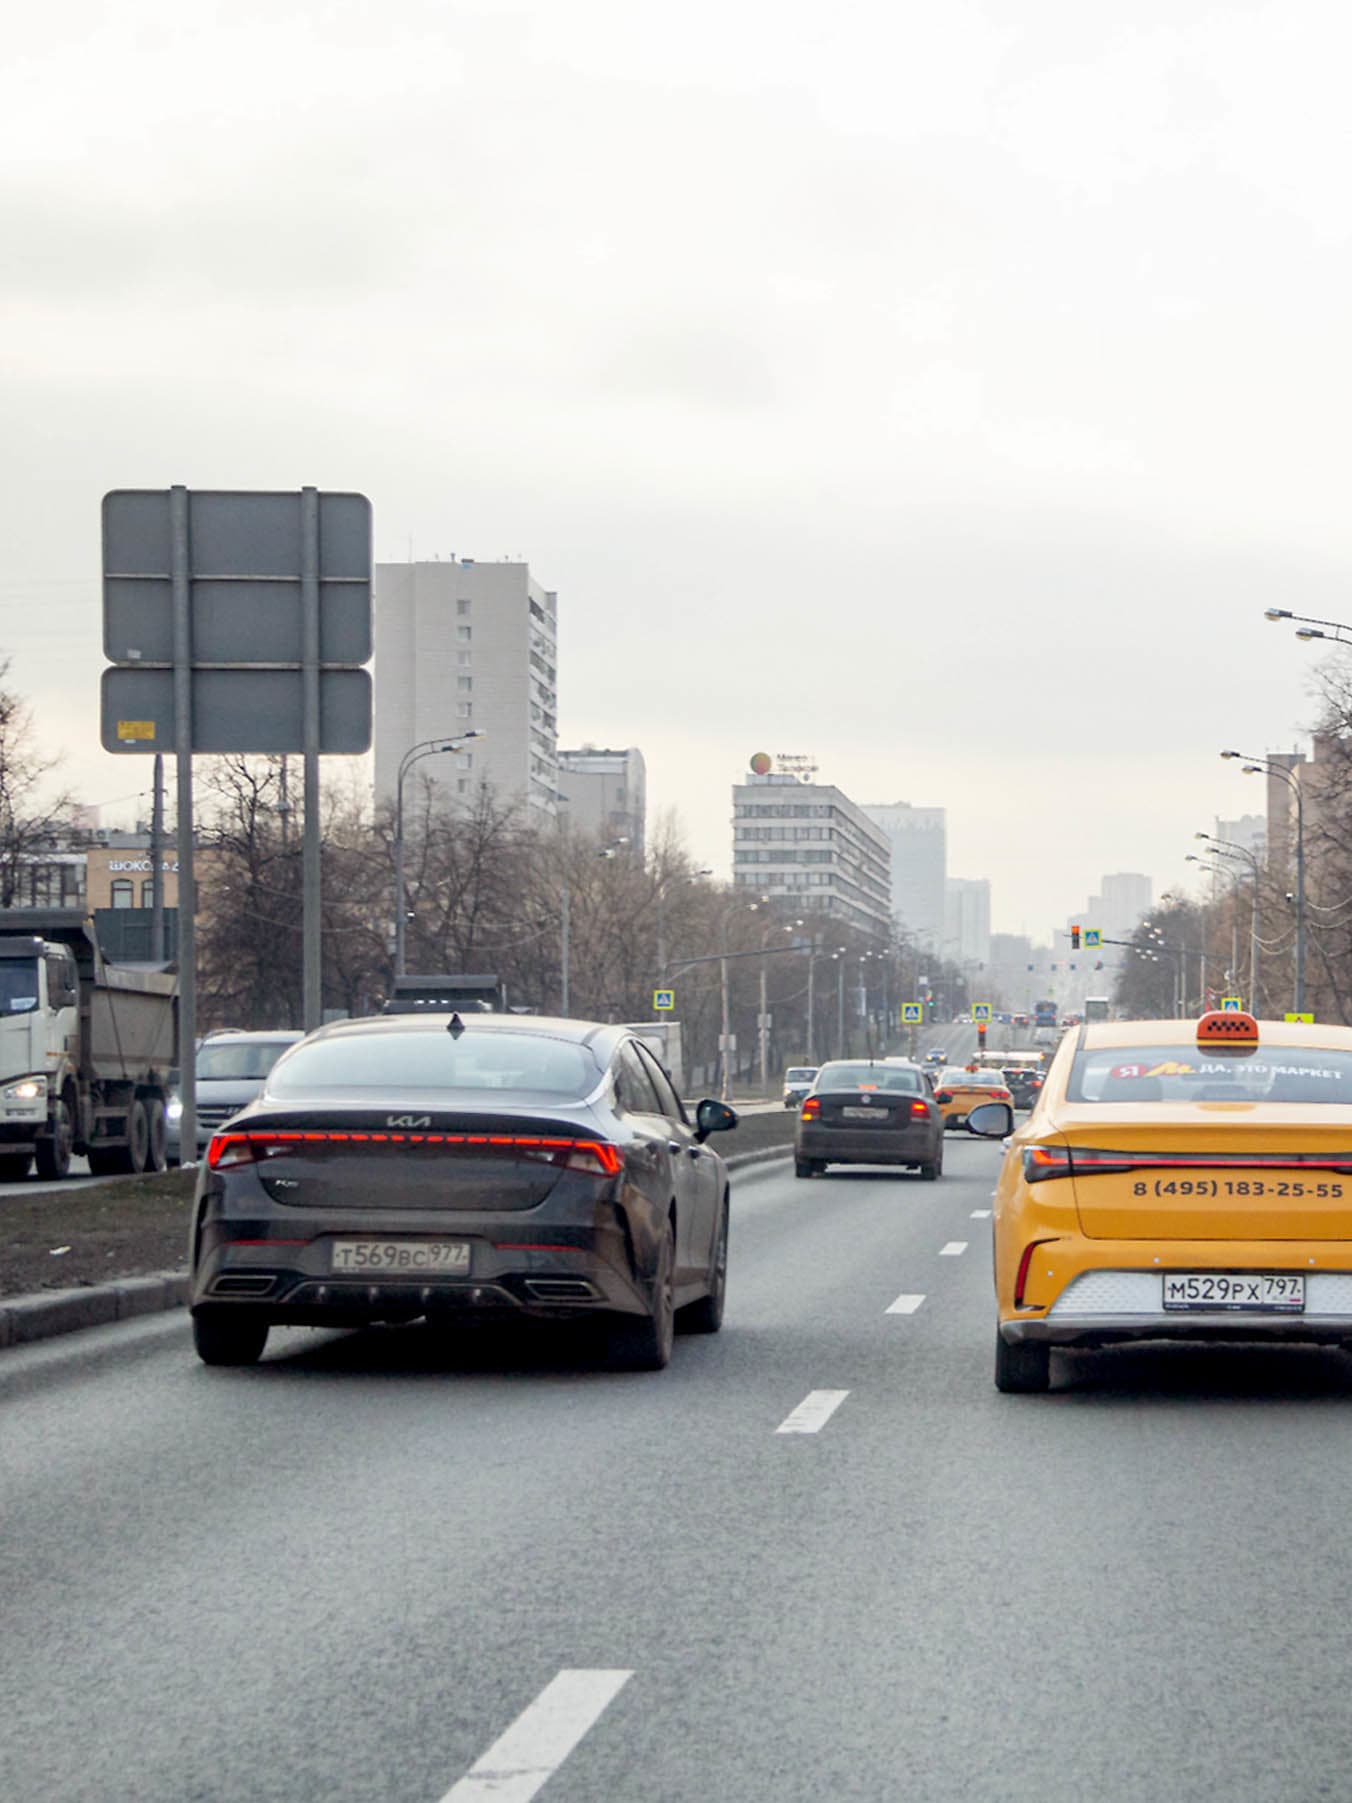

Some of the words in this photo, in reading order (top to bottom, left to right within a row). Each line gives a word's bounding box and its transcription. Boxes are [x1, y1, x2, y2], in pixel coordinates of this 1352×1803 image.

[1237, 1064, 1267, 1073] ЭТО
[1270, 1066, 1343, 1079] МАРКЕТ
[387, 1115, 432, 1127] KIA
